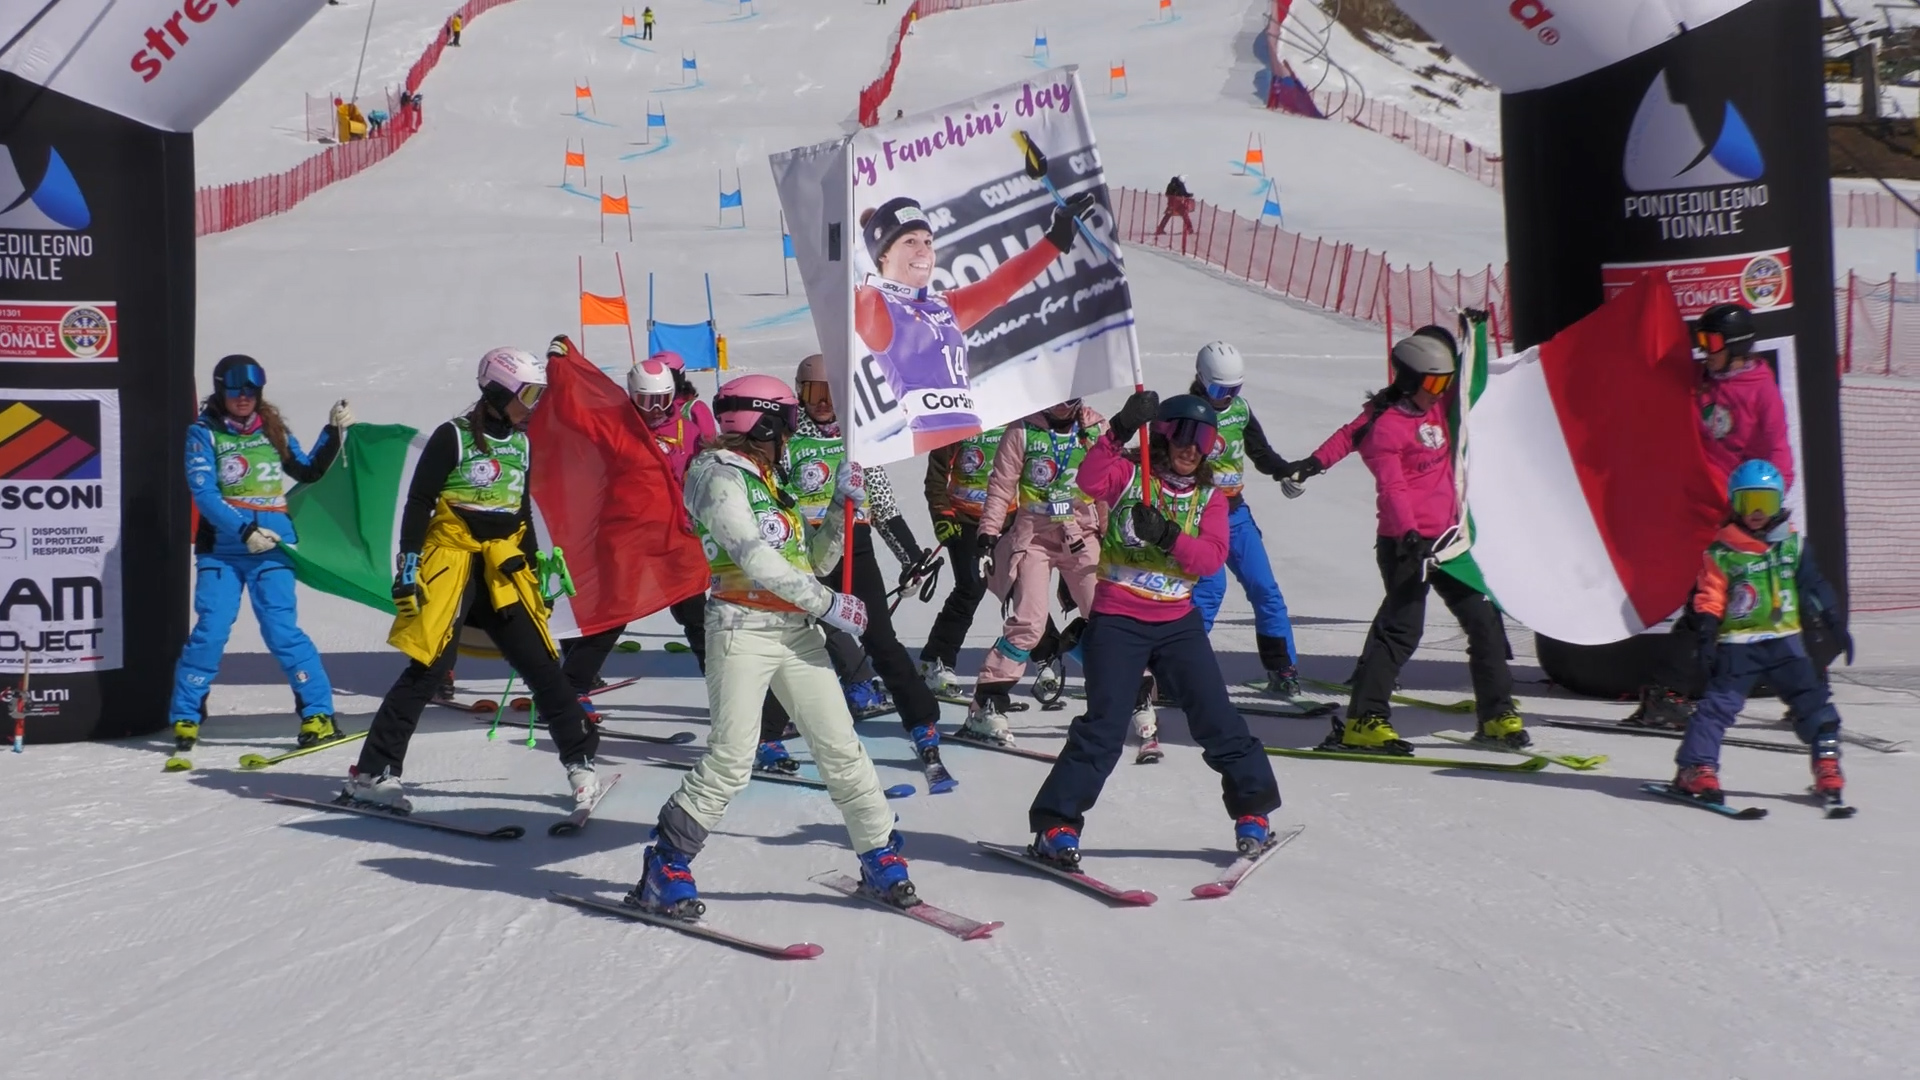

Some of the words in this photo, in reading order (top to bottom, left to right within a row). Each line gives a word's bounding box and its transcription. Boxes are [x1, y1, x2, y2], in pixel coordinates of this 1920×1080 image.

[131, 0, 240, 83] stre
[882, 103, 1008, 171] Fanchini
[1015, 83, 1073, 117] day
[1624, 184, 1769, 219] PONTEDILEGNO
[1658, 211, 1744, 240] TONALE
[0, 257, 63, 280] NALE
[1674, 287, 1740, 307] TONALE
[1034, 296, 1068, 325] for
[17, 325, 54, 334] SCHOOL
[942, 345, 968, 386] 14
[752, 399, 780, 412] POC
[1052, 502, 1070, 515] VIP
[32, 527, 88, 536] DISPOSITIVI
[32, 537, 43, 546] DI
[45, 536, 104, 546] PROTEZIONE
[32, 546, 100, 555] RESPIRATORIA
